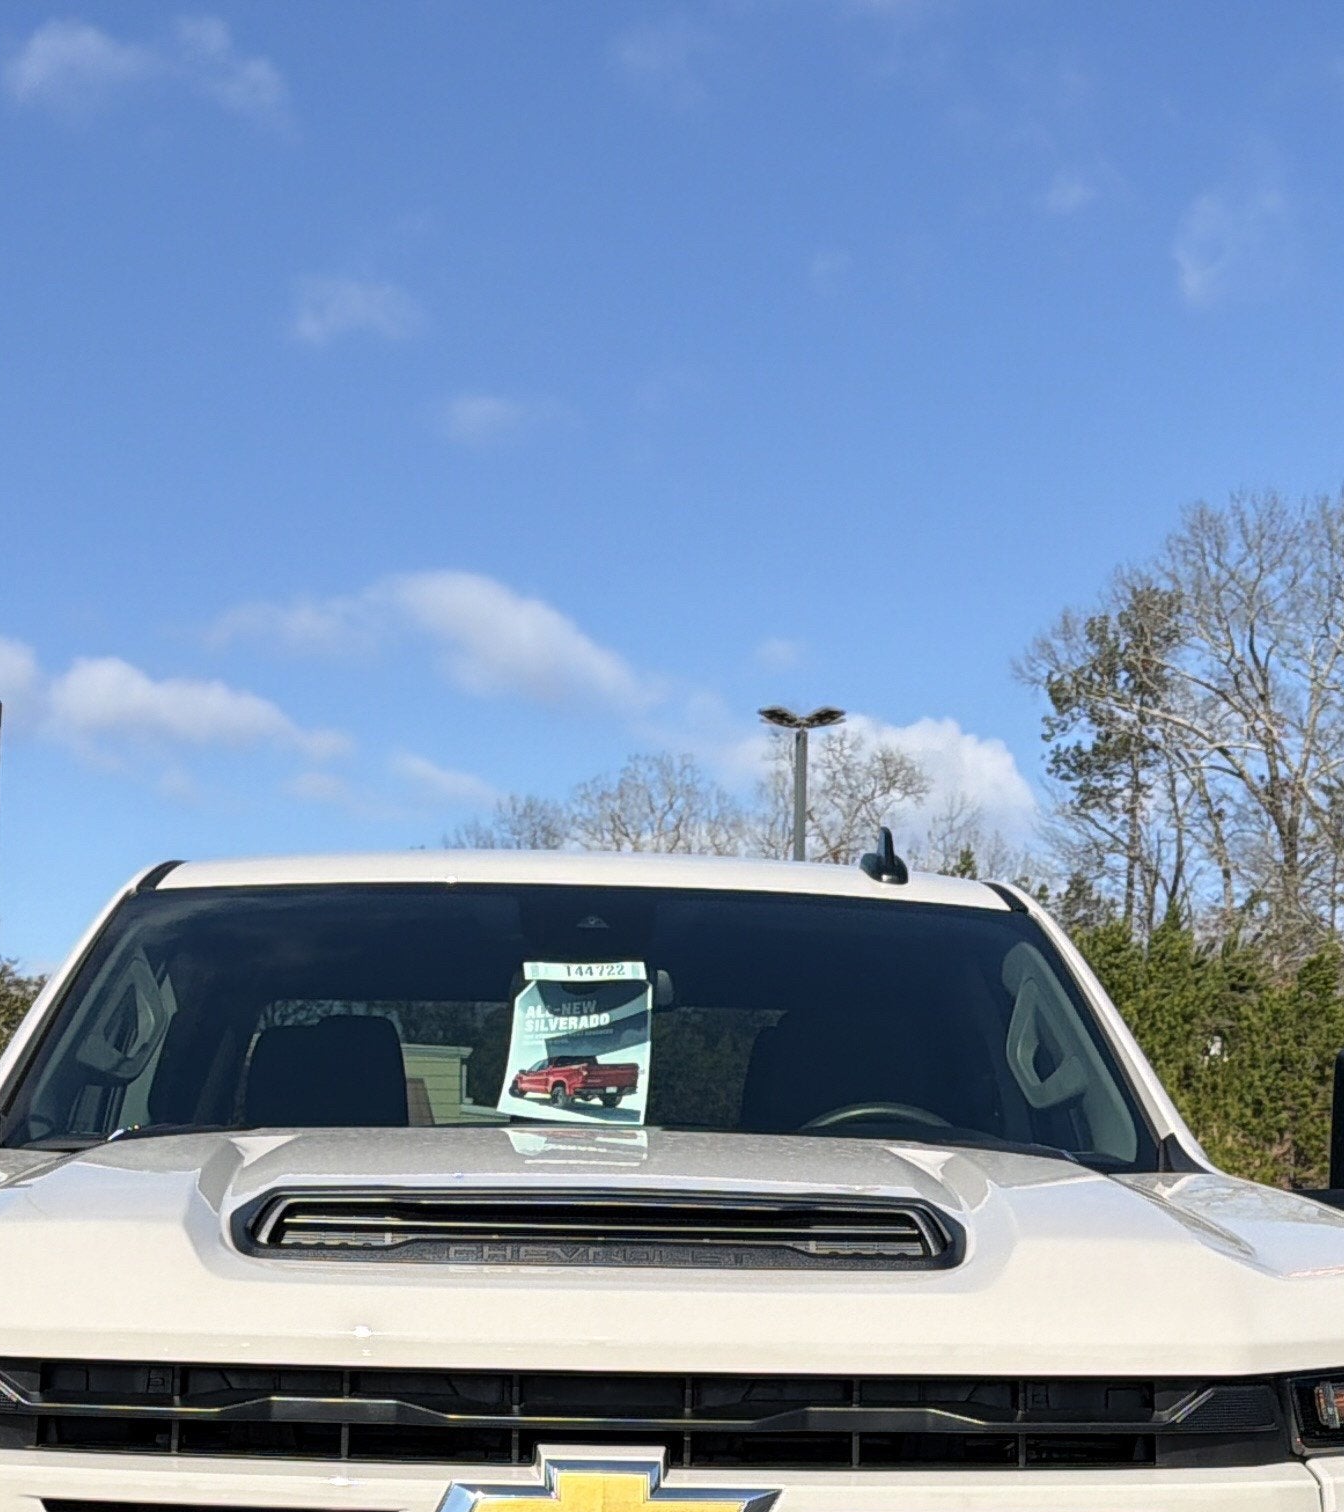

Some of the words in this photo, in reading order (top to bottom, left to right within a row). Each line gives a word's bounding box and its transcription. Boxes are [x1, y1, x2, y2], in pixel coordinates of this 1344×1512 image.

[565, 964, 626, 977] 144722
[525, 1000, 597, 1017] ALL-NEW
[524, 1012, 611, 1032] SILVERADO
[449, 1246, 753, 1265] CHEVROLET
